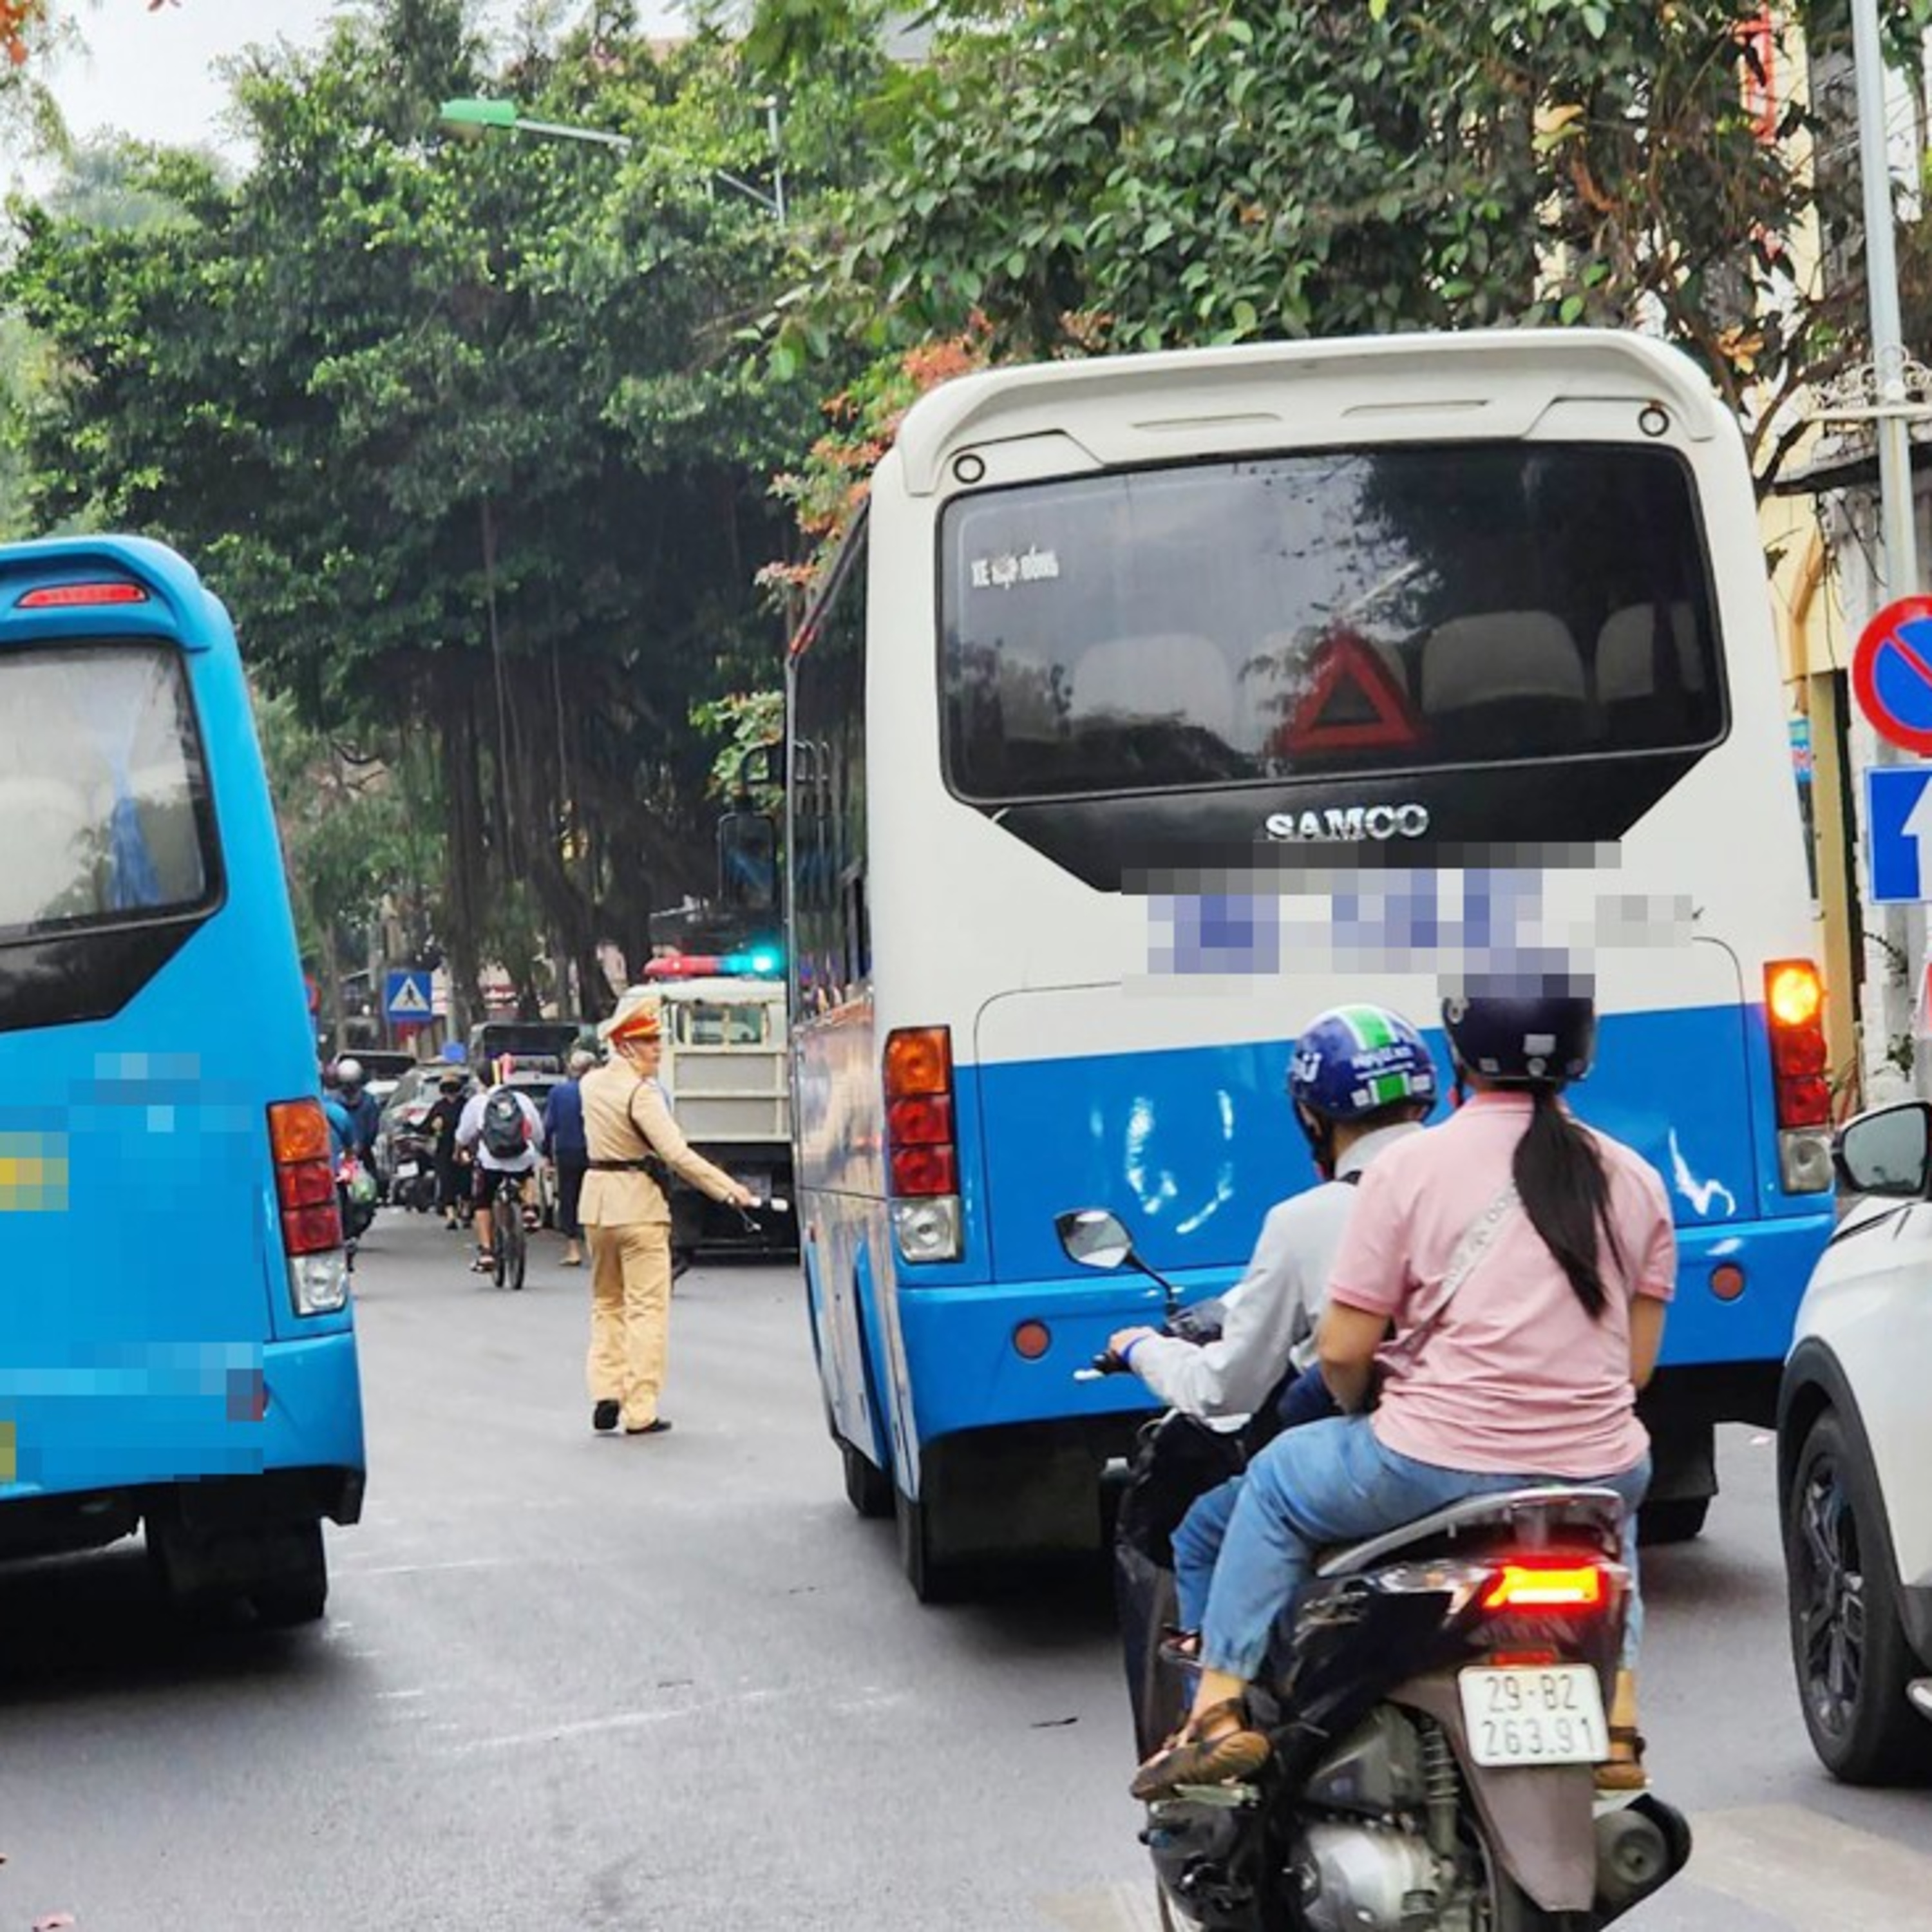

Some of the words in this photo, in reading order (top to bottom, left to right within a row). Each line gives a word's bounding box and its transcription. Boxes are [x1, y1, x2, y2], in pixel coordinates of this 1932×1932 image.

[1265, 804, 1429, 839] SAMCO
[1485, 1674, 1578, 1712] 29-B2
[1482, 1718, 1595, 1756] 263.91
